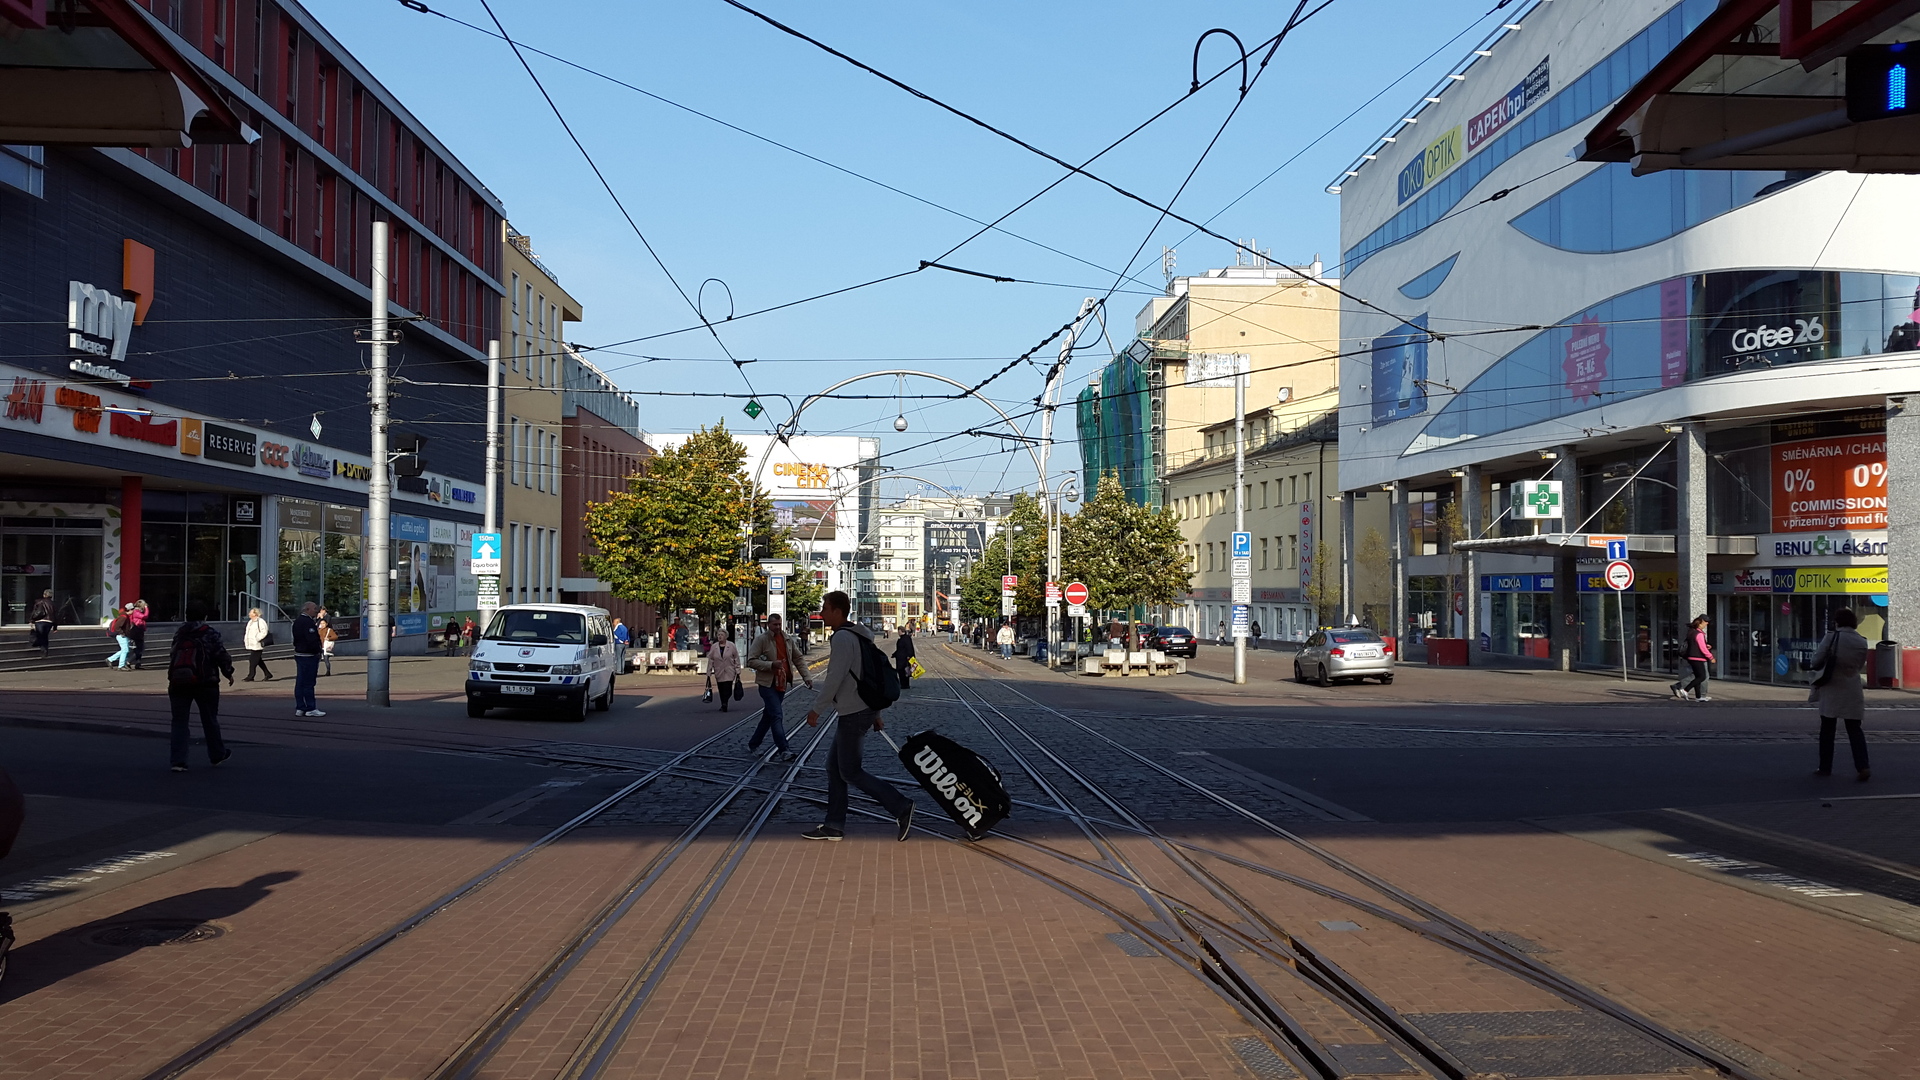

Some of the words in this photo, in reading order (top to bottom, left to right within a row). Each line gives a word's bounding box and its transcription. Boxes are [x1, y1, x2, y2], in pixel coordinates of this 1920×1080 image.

[1402, 158, 1423, 198] OKO
[1426, 130, 1456, 179] OPTIK
[68, 281, 137, 361] my
[1793, 316, 1825, 344] 26
[4, 376, 46, 424] H&M
[1787, 427, 1815, 437] UNION
[209, 434, 256, 456] RESERVED
[261, 441, 289, 468] CCC
[773, 462, 830, 477] CINEMA
[796, 476, 830, 489] CITY
[1784, 468, 1815, 493] 0%
[1790, 496, 1887, 512] COMMISSION
[1235, 534, 1247, 550] P
[1775, 541, 1812, 556] BENU
[1498, 578, 1521, 589] NOKIA
[1742, 575, 1770, 586] rebeka
[1774, 574, 1794, 588] OKO
[1799, 574, 1832, 588] OPTIK
[914, 745, 982, 829] Wilson
